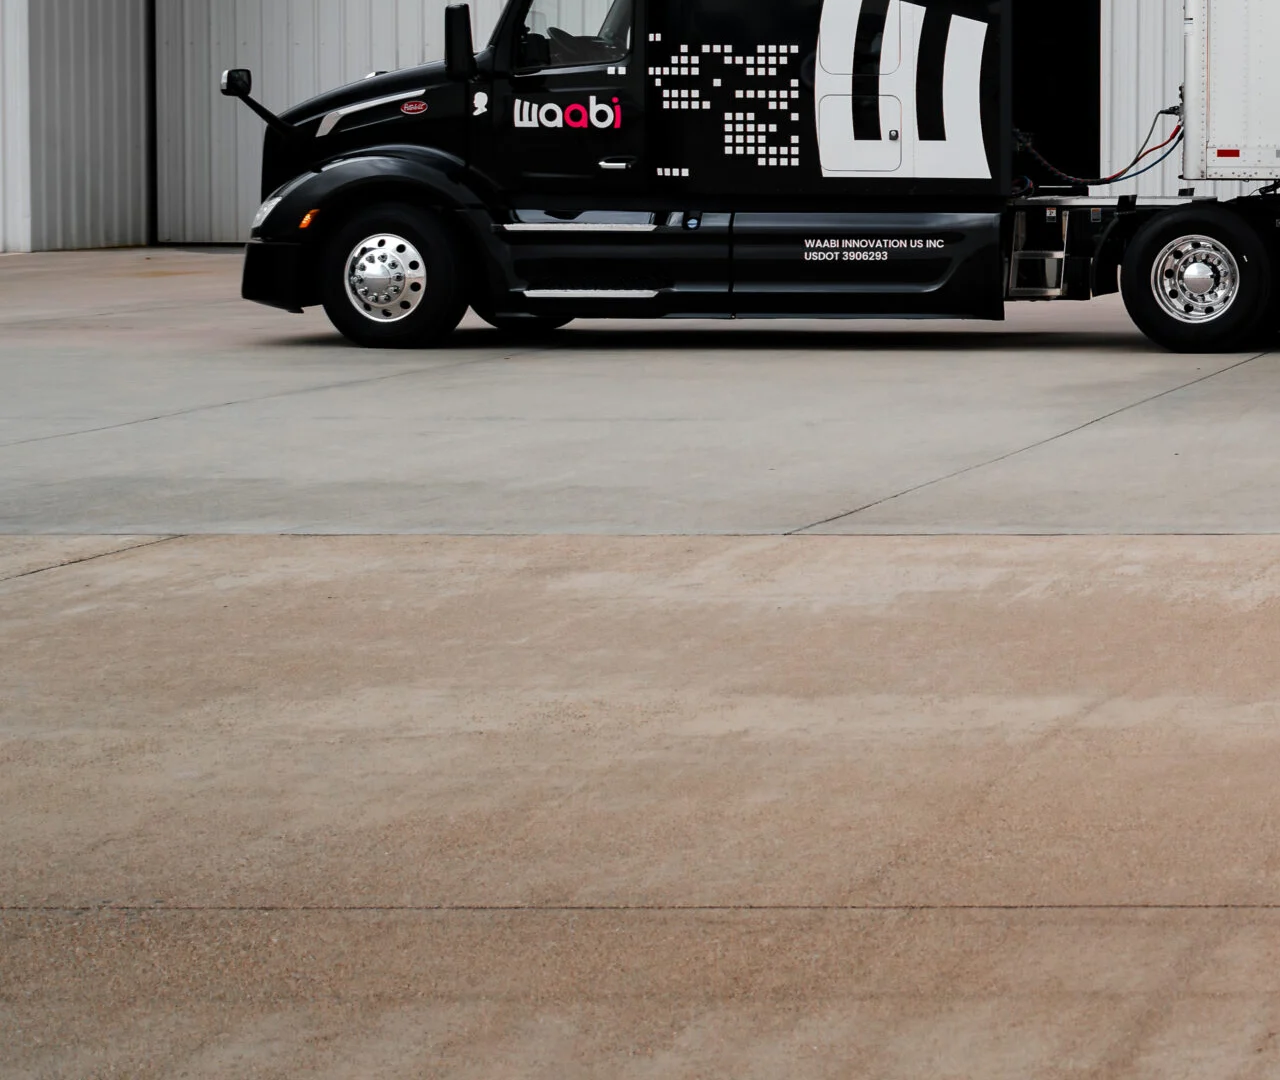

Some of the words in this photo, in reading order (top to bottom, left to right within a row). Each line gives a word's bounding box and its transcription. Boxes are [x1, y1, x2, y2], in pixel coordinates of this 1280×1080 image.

[514, 95, 621, 128] waabi
[804, 239, 839, 248] WAABI
[842, 239, 907, 248] INNOVATION
[909, 239, 924, 248] US
[926, 239, 945, 248] INC
[804, 251, 840, 261] USDOT
[842, 251, 888, 261] 3906293
